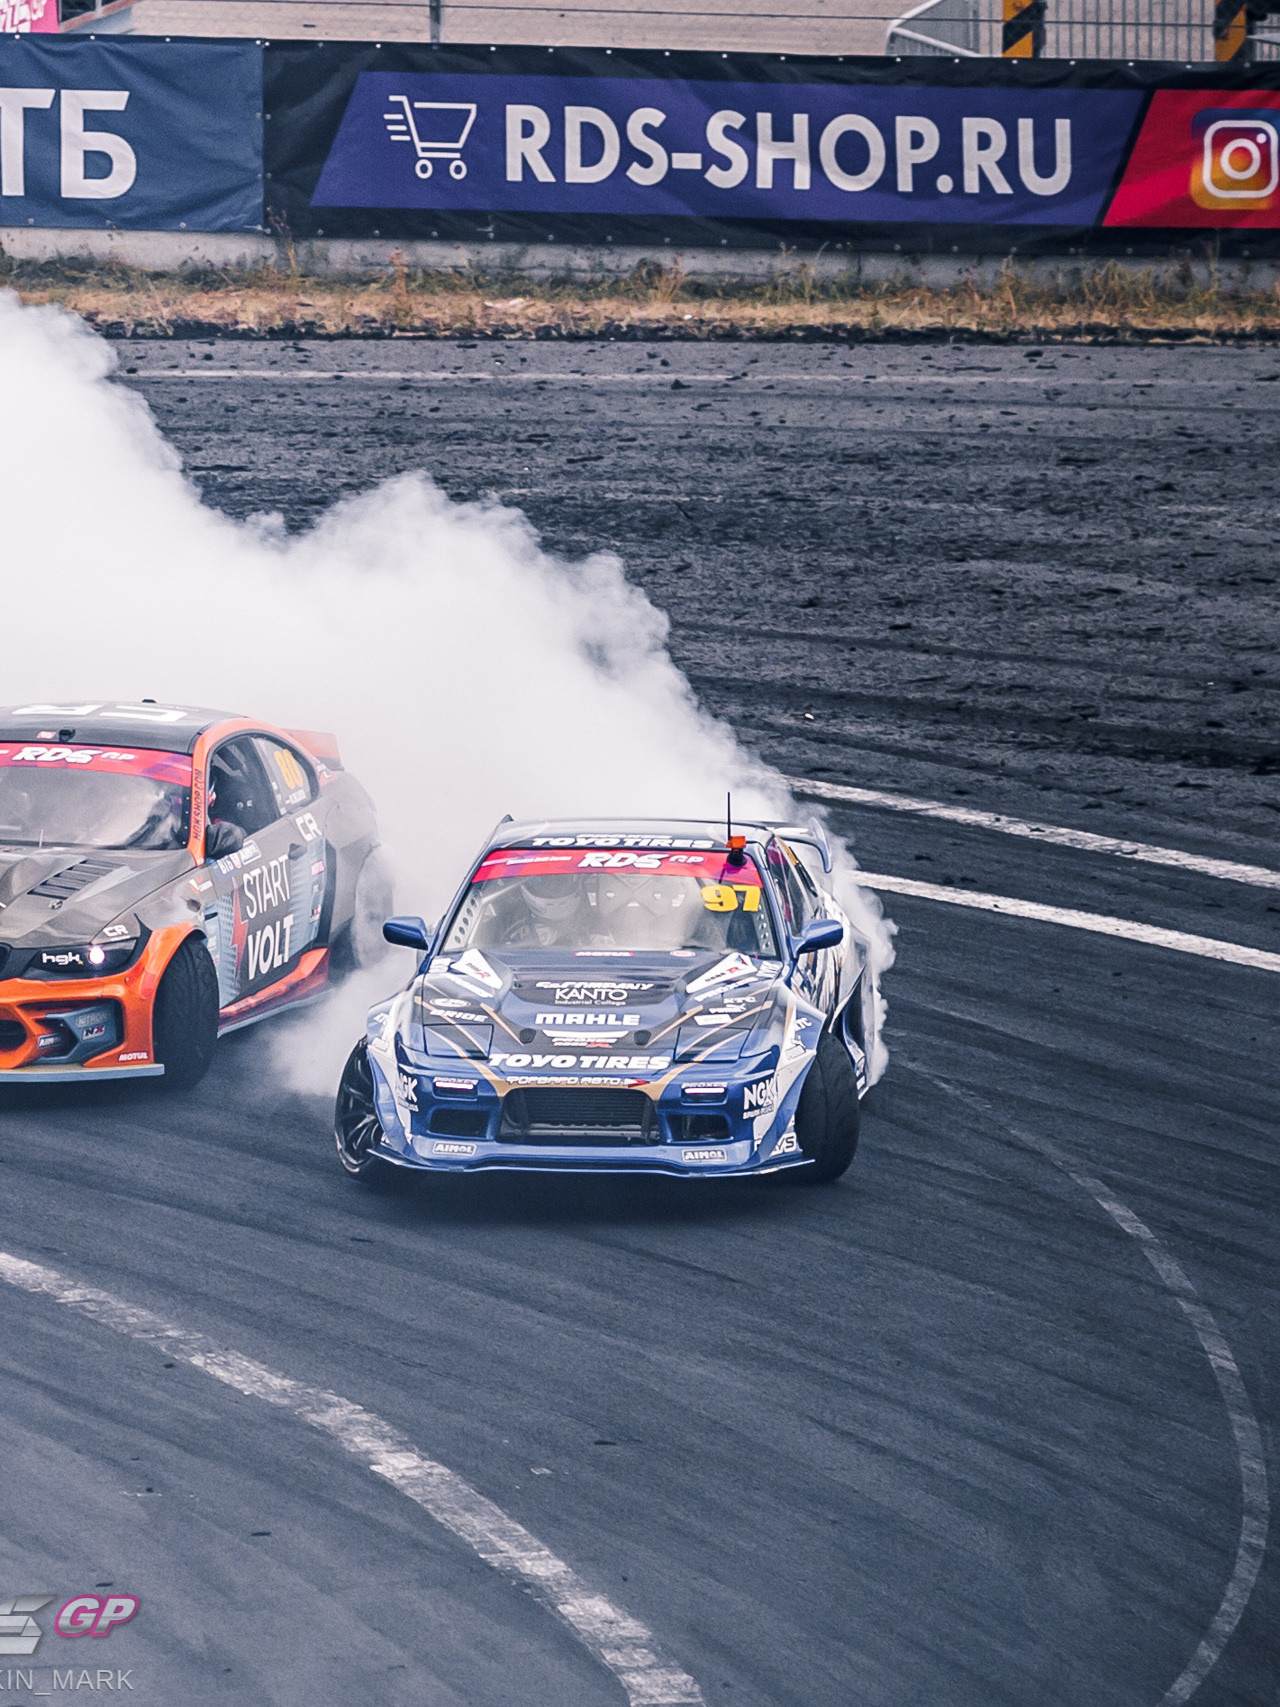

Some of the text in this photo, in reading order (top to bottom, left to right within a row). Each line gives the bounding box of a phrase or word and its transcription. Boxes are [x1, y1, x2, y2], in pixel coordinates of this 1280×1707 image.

[504, 104, 1073, 198] RDS-SHOP.RU
[12, 746, 102, 764] RDS
[294, 812, 322, 842] CR
[531, 837, 714, 848] TOYO TIRES
[578, 852, 669, 868] RDS
[242, 854, 291, 919] START
[701, 885, 761, 912] 97
[248, 914, 294, 980] VOLT
[42, 951, 81, 966] hgk
[555, 988, 628, 1001] KANTO
[429, 1009, 489, 1023] BRIDE
[535, 1013, 641, 1026] MAHLE
[489, 1053, 671, 1070] TOYO TIRES
[743, 1078, 775, 1110] NGK
